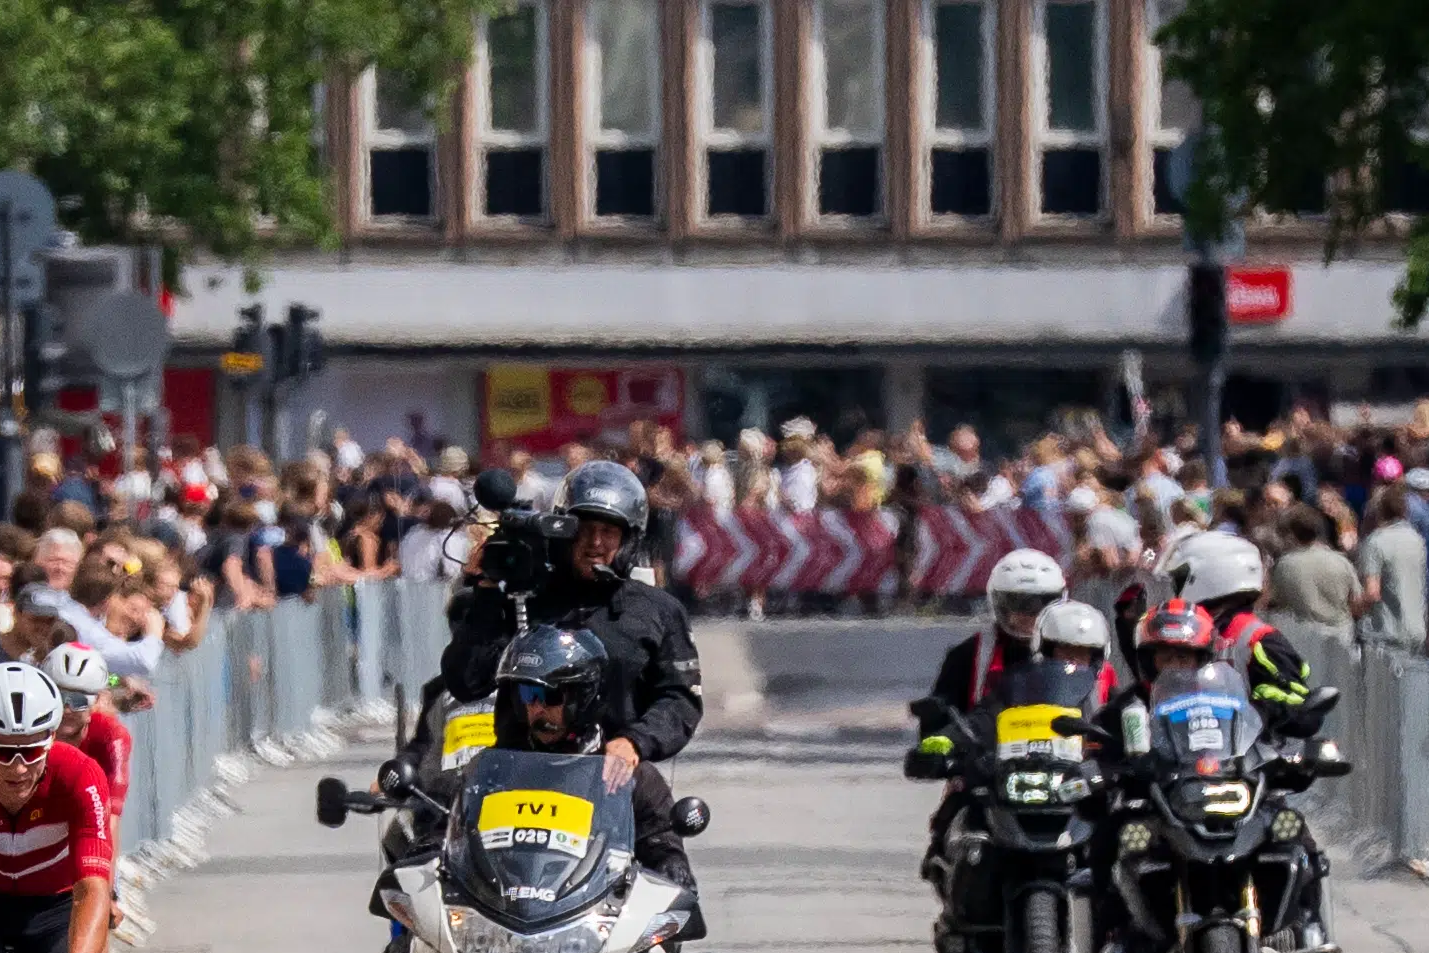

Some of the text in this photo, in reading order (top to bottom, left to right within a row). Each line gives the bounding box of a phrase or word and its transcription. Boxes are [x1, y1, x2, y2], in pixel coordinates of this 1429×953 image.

[85, 784, 107, 840] postnord
[515, 803, 544, 815] TV
[514, 829, 548, 844] 025
[518, 886, 556, 902] EMG
